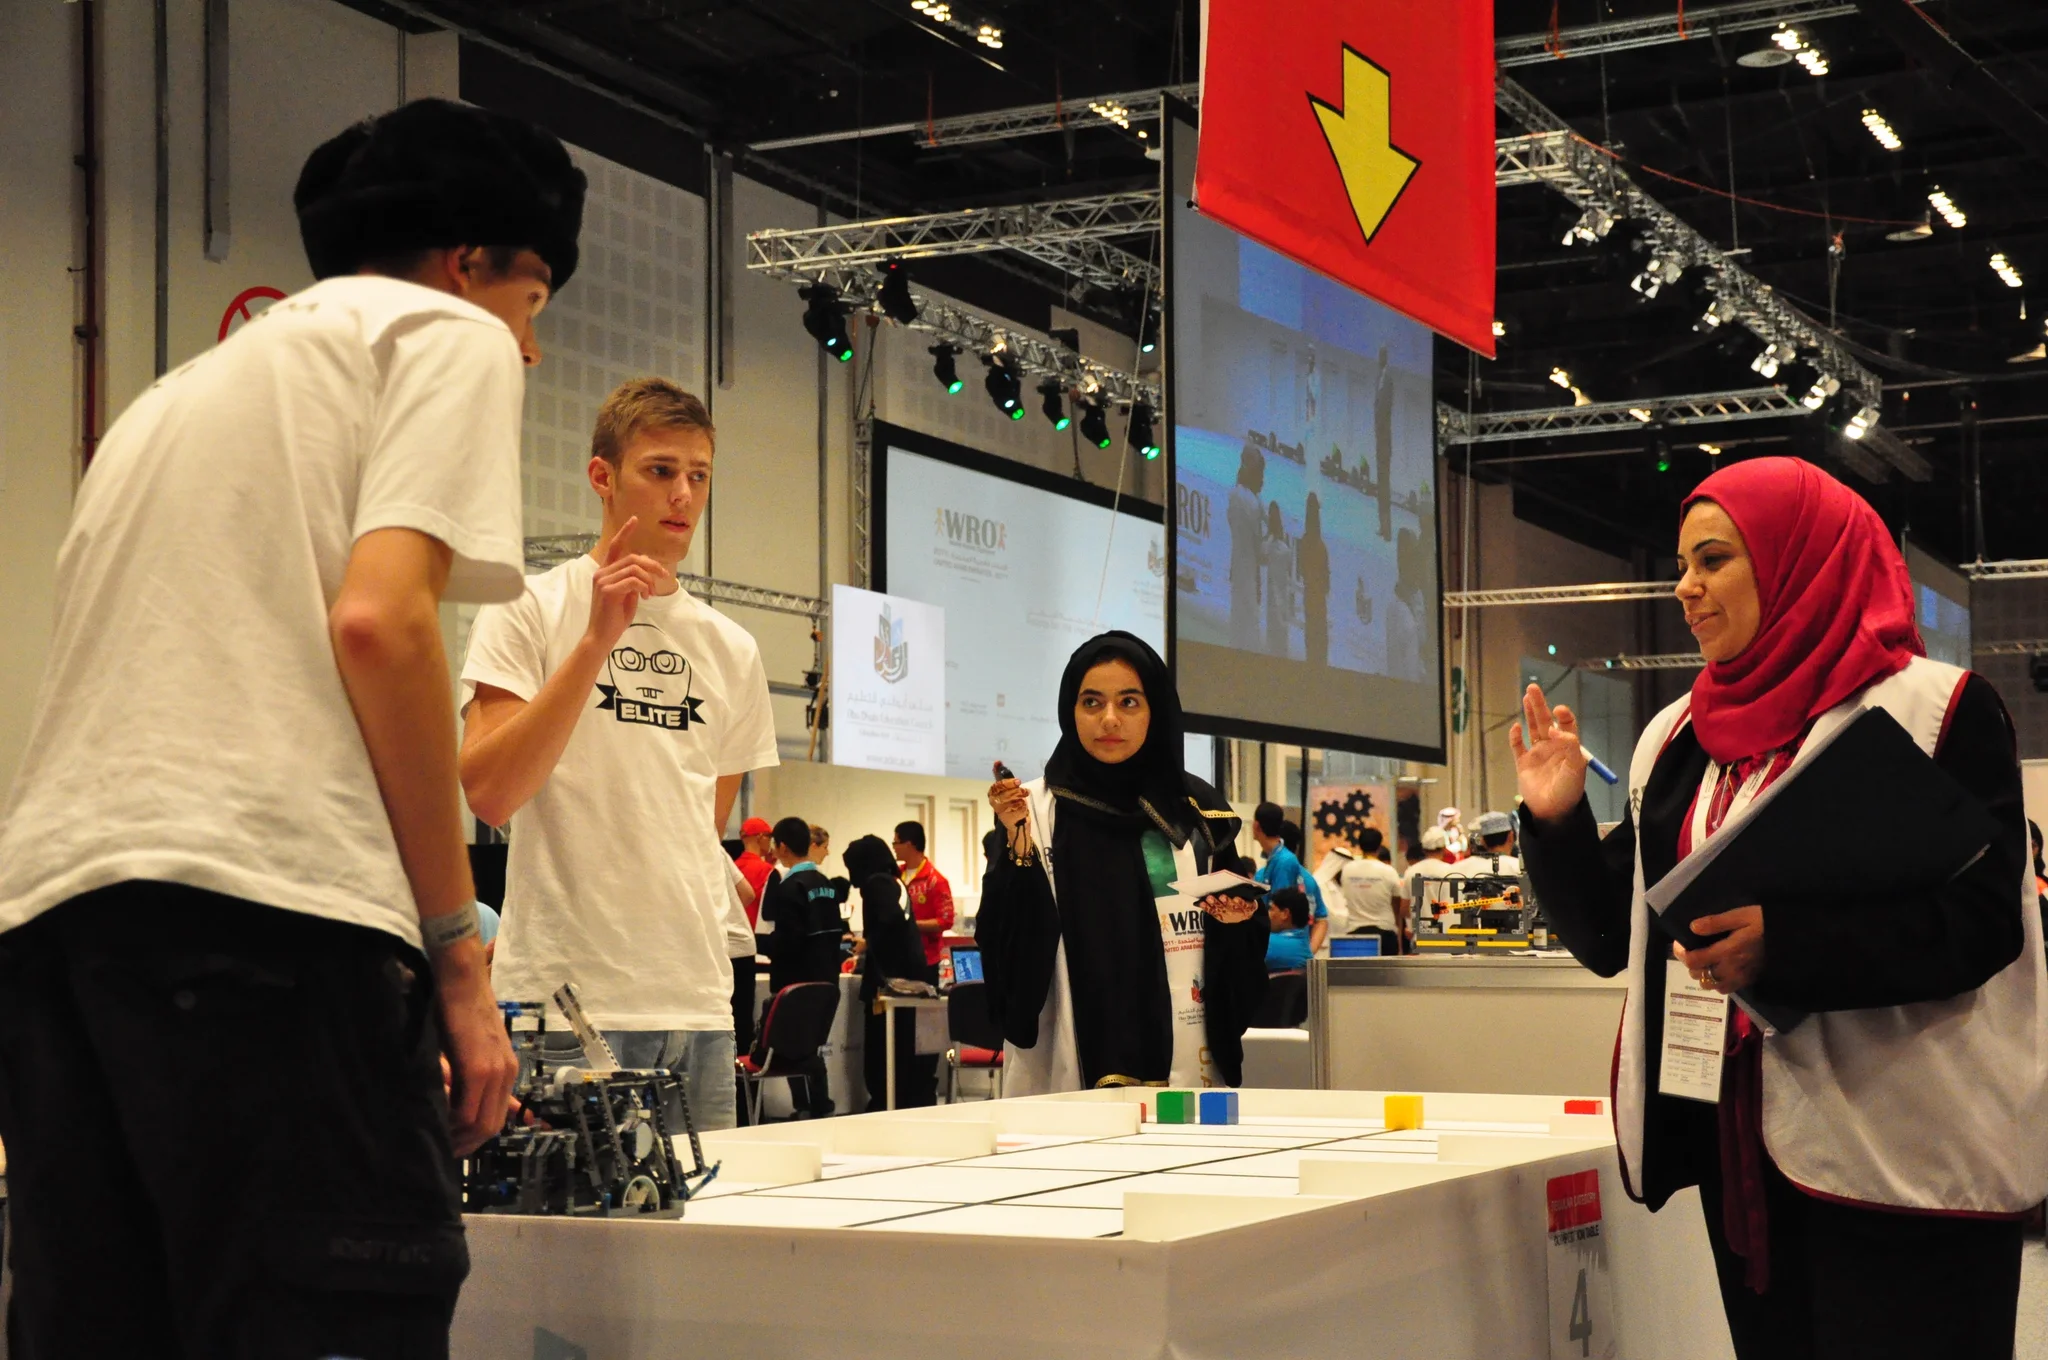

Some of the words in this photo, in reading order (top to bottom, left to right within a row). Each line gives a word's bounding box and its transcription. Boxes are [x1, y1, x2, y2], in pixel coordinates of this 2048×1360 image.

[944, 509, 997, 549] WRO
[1177, 482, 1202, 534] RO
[620, 702, 682, 727] ELITE
[1569, 1268, 1593, 1358] 4
